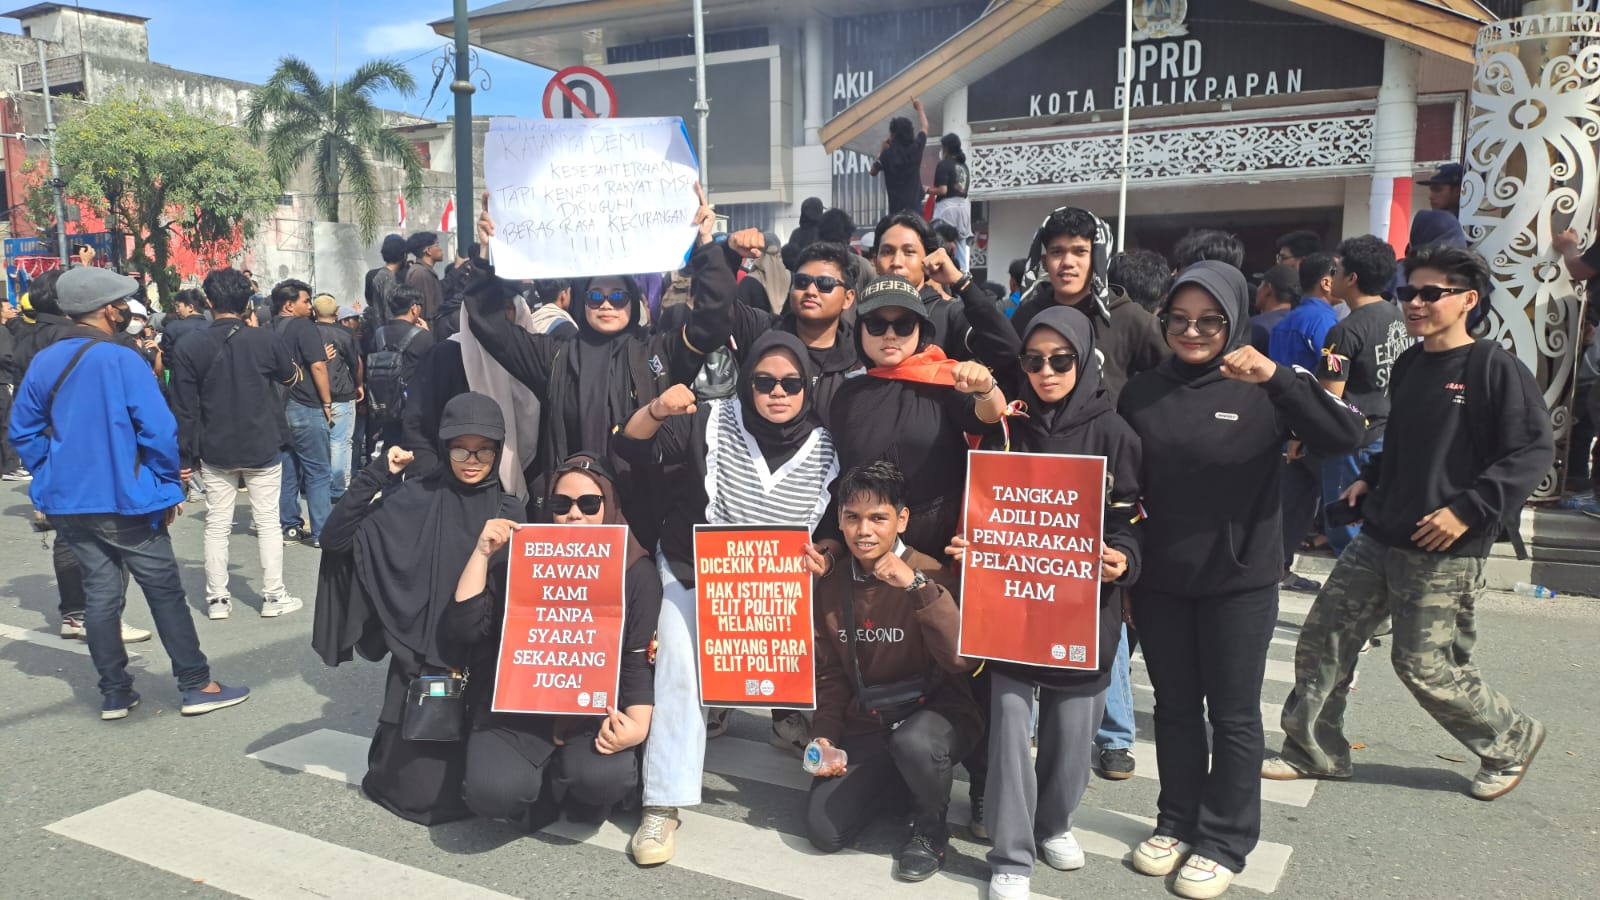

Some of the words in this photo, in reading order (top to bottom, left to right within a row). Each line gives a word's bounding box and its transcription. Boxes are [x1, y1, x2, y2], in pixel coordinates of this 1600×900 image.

[1117, 40, 1202, 83] DPRD
[833, 70, 873, 99] AKU
[1029, 89, 1096, 117] KOTA
[1113, 68, 1302, 110] BALIKPAPAN
[591, 130, 645, 155] DEMI
[496, 185, 535, 208] TAPI
[544, 183, 600, 204] KENAPA
[605, 180, 653, 195] RAKYAT
[503, 219, 556, 245] BERAS
[559, 217, 596, 235] RASA
[992, 485, 1079, 506] TANGKAP
[988, 511, 1036, 527] ADILI
[1039, 511, 1080, 529] DAN
[727, 540, 779, 557] RAKYAT
[972, 528, 1094, 553] PENJARAKAN
[524, 541, 611, 558] BEBASKAN
[532, 564, 600, 579] KAWAN
[700, 556, 755, 575] DICEKIK
[758, 556, 807, 573] PAJAK!
[970, 551, 1094, 579] PELANGGAR
[542, 586, 588, 601] KAMI
[706, 581, 735, 599] HAK
[737, 581, 802, 599] ISTIMEWA
[1004, 579, 1056, 601] HAM
[536, 607, 594, 622] TANPA
[711, 599, 742, 616] ELIT
[744, 599, 797, 616] POLITIK
[718, 616, 791, 632] MELANGIT!
[527, 629, 597, 644] SYARAT
[838, 627, 905, 643] 3ECOND
[705, 639, 768, 656] GANYANG
[771, 639, 807, 656] PARA
[513, 650, 606, 667] SEKARANG
[714, 656, 744, 672] ELIT
[747, 656, 800, 672] POLITIK
[532, 673, 582, 689] JUGA!
